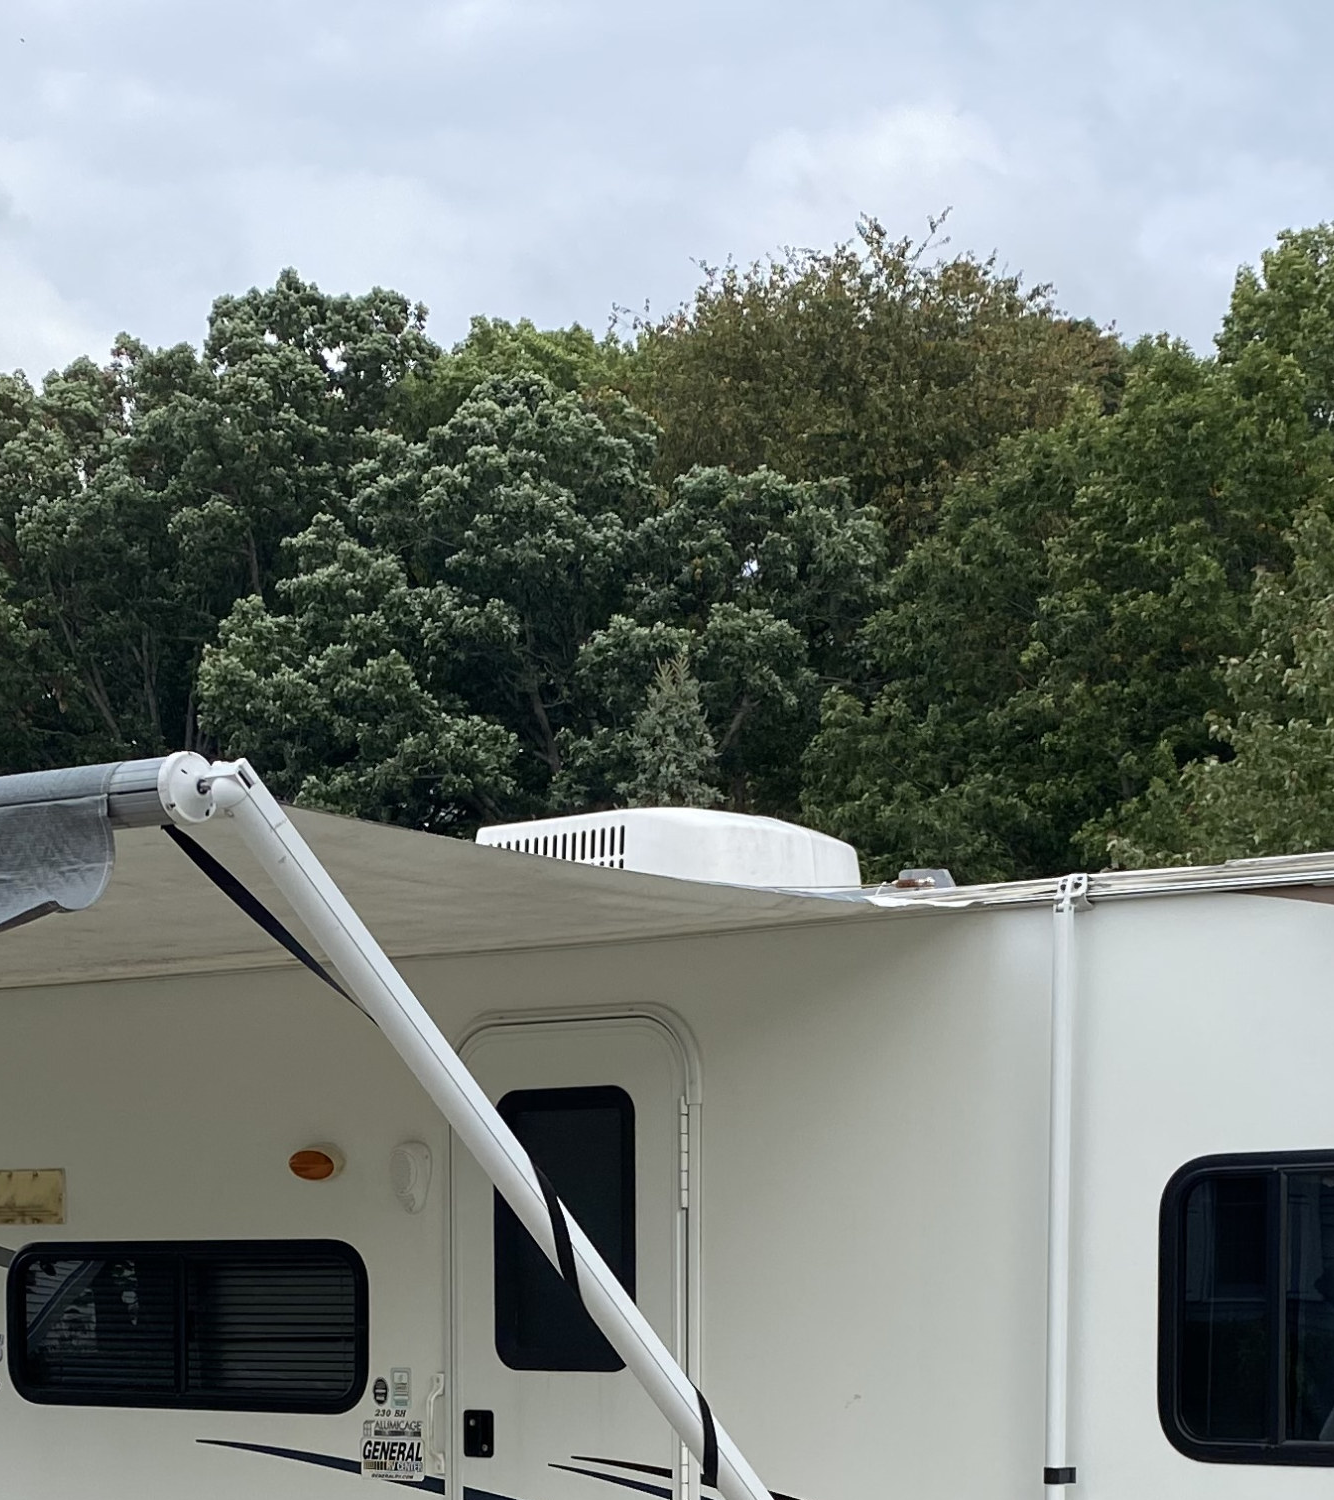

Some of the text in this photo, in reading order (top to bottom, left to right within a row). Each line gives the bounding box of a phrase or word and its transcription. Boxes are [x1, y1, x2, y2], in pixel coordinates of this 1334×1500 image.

[374, 1408, 407, 1418] 230 BH
[362, 1440, 423, 1462] GENERAL
[396, 1461, 423, 1473] CENTER
